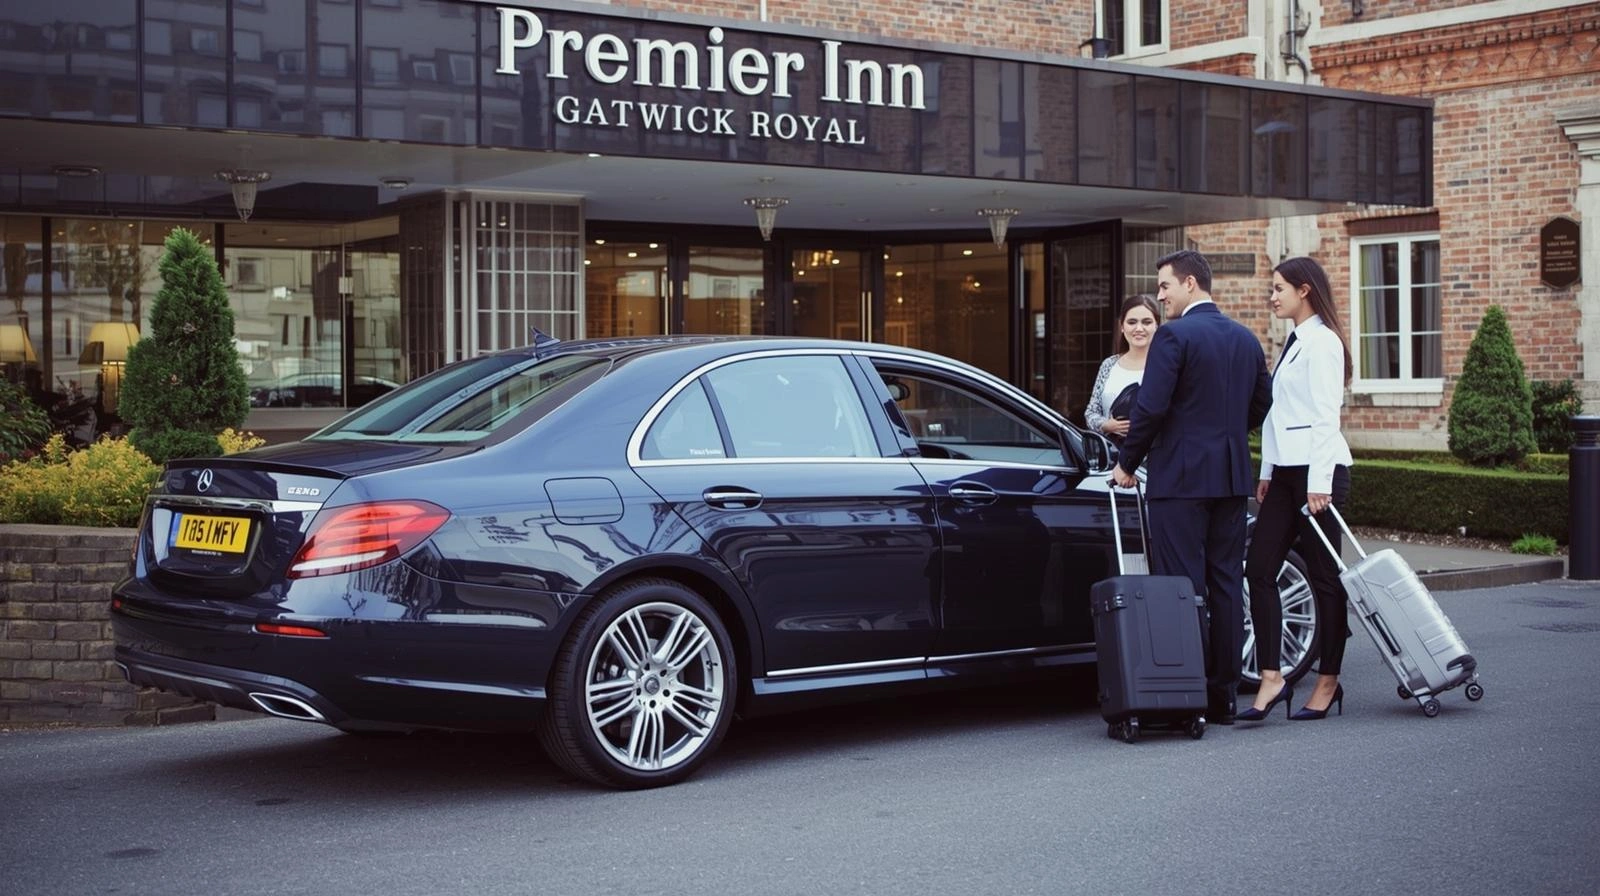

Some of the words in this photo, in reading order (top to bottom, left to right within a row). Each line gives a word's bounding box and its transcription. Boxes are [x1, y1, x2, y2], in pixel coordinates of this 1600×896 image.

[496, 7, 804, 97] Premier
[822, 41, 925, 109] Inn
[556, 96, 736, 135] GATWICK
[750, 112, 866, 145] ROYAL
